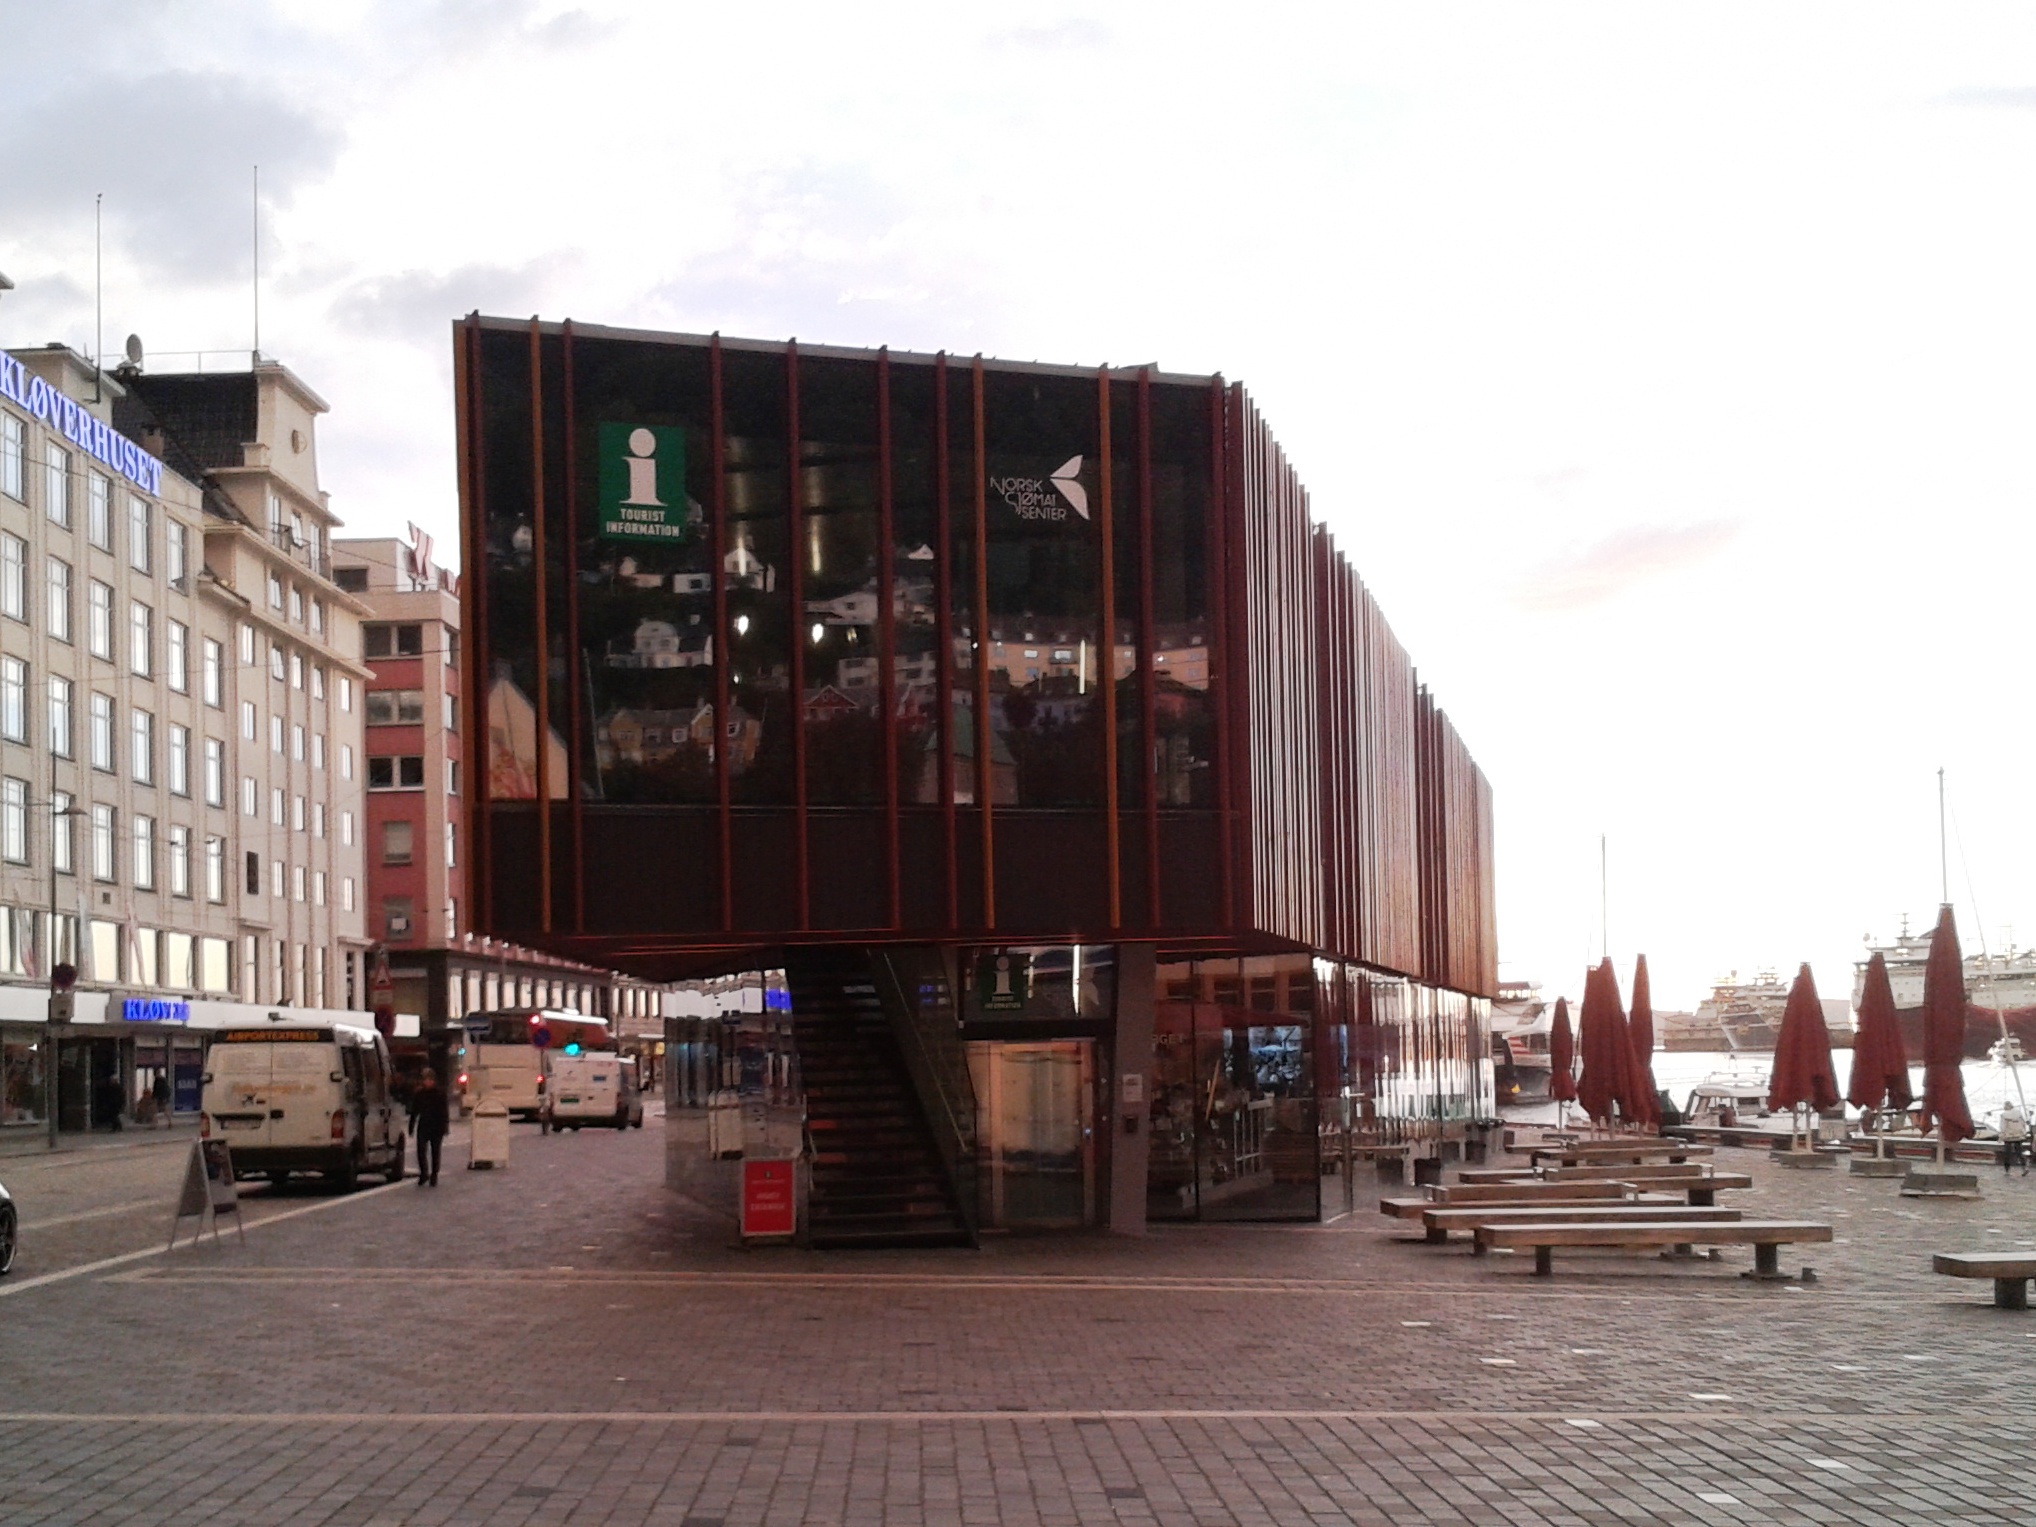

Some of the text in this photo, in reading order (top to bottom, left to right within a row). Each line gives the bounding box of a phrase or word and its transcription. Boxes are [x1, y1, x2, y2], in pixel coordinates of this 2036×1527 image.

[0, 350, 163, 497] KLØVERHUSET
[990, 476, 1043, 495] NORSK
[620, 508, 665, 522] TOURIST
[1021, 506, 1067, 520] SENTER
[606, 521, 680, 537] INFORMATION
